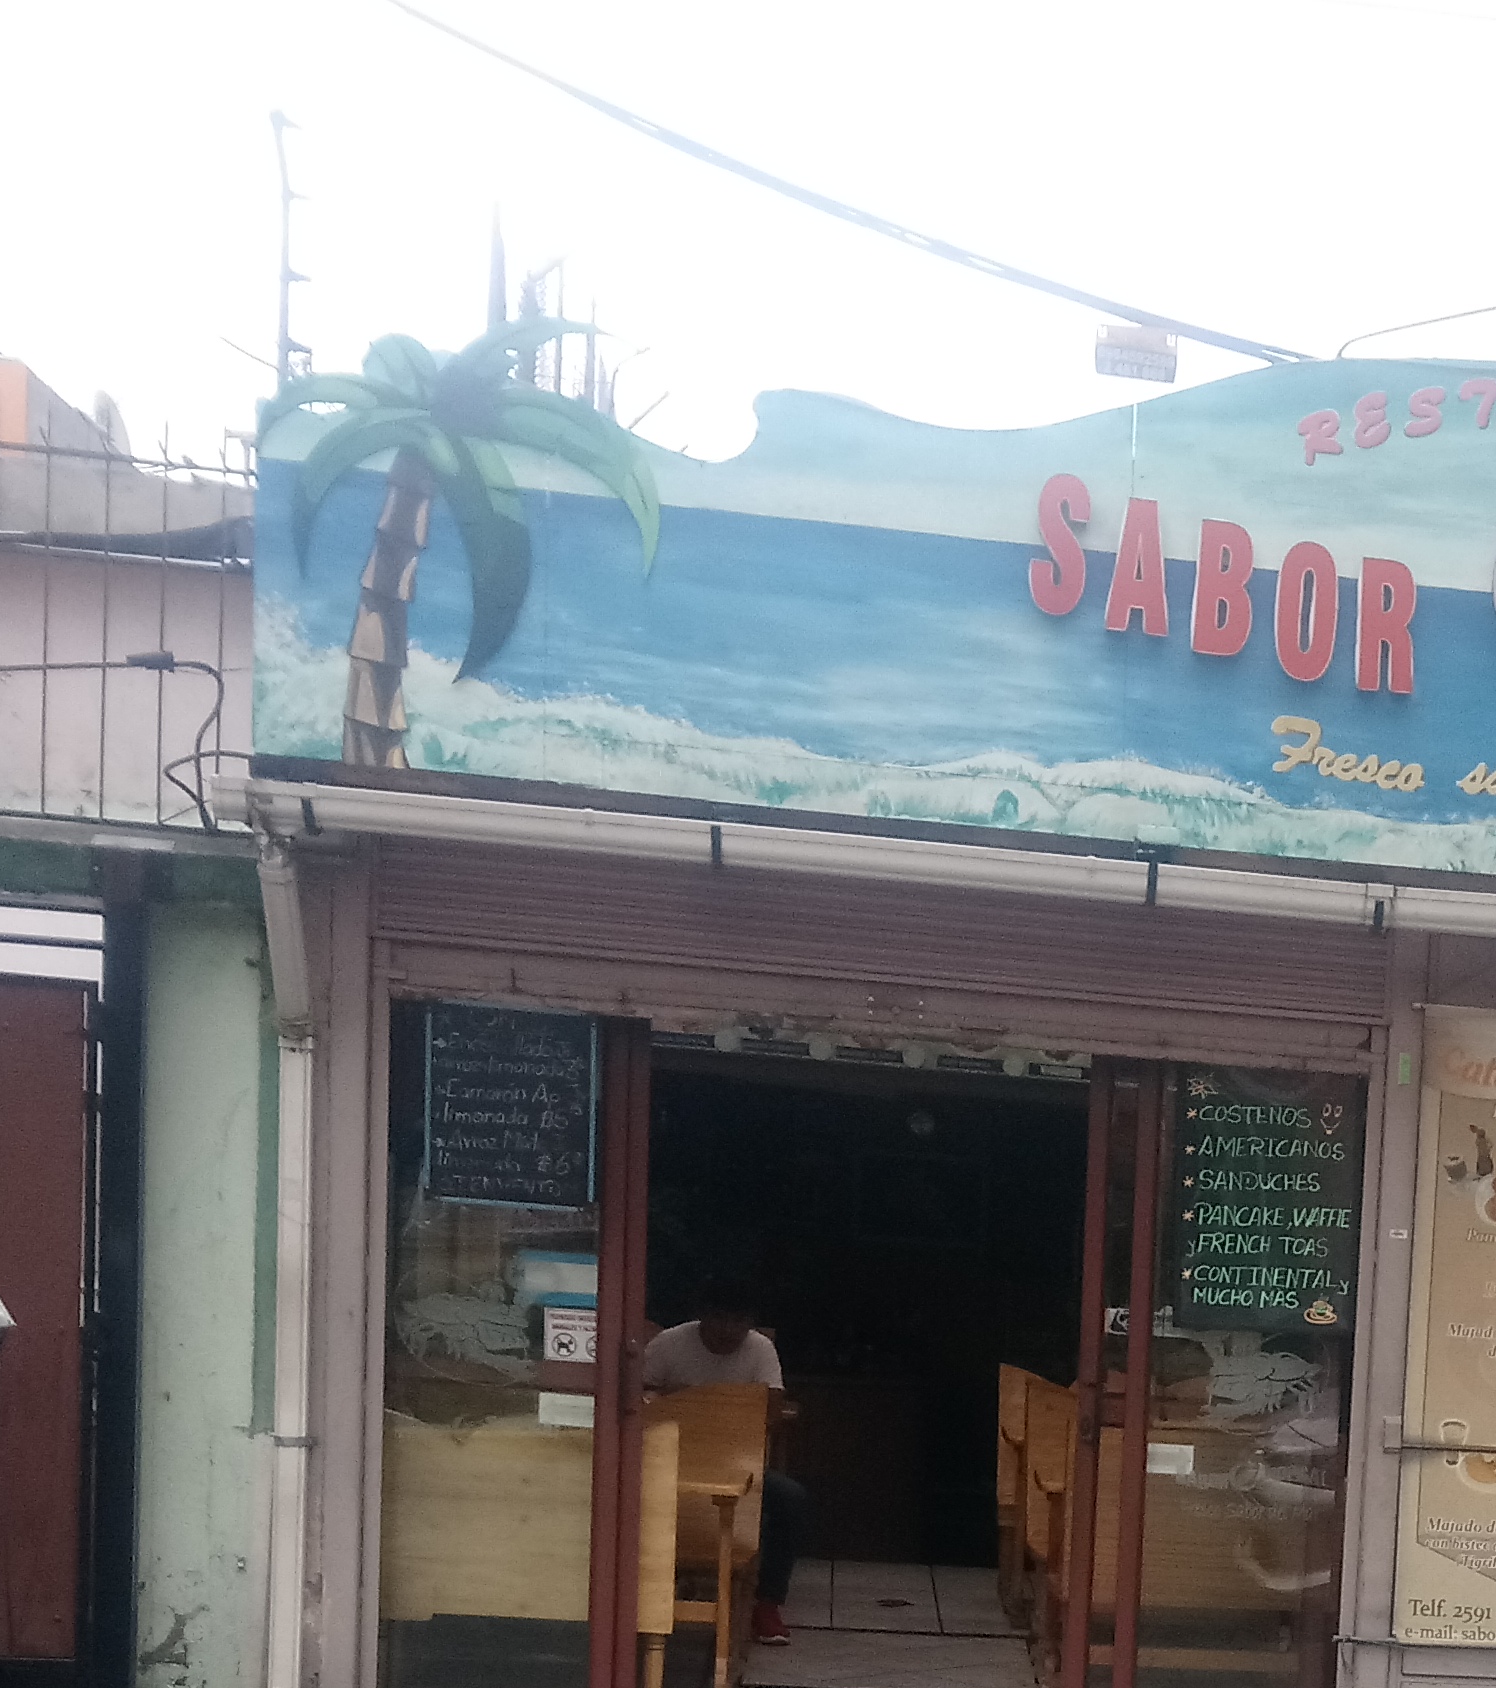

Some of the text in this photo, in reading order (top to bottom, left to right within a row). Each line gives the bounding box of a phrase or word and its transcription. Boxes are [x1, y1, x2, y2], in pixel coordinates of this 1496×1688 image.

[1028, 473, 1417, 695] SABOR
[1271, 715, 1424, 793] Fresco
[1198, 1135, 1345, 1161] AMERICANOS
[1199, 1169, 1321, 1192] SANDUCHES
[1194, 1265, 1338, 1289] CONTINENTAL
[1193, 1287, 1254, 1306] MUCHO
[1408, 1599, 1447, 1617] Telf.
[1453, 1605, 1491, 1622] 2591
